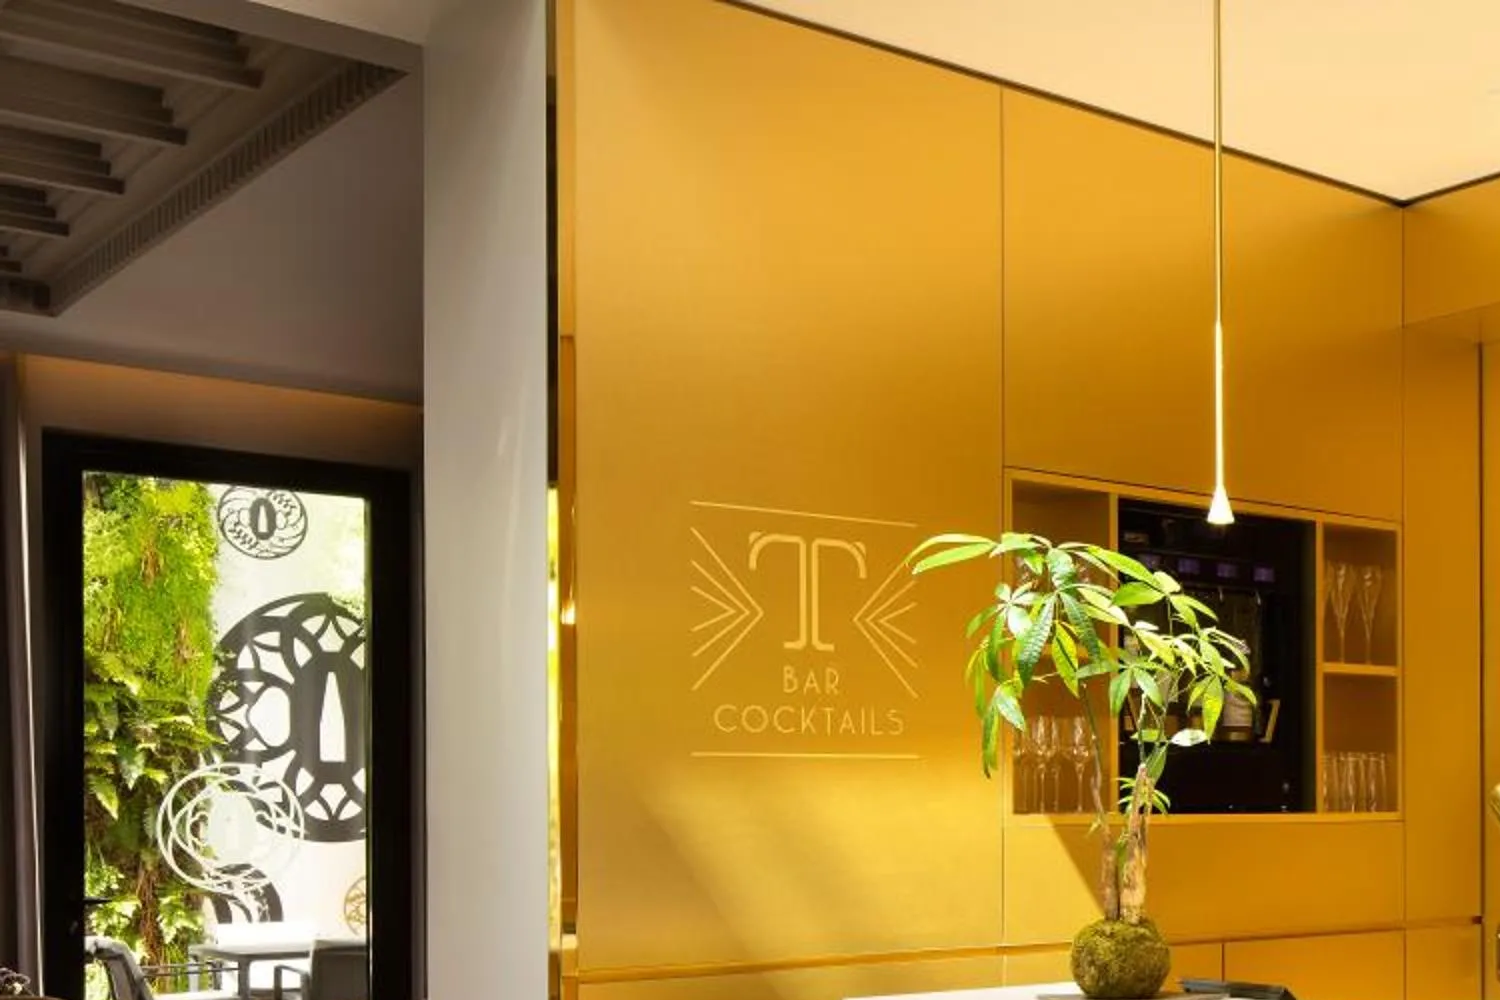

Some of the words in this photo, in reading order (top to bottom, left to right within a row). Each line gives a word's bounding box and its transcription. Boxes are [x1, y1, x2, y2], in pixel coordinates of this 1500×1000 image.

[749, 532, 867, 651] T
[783, 665, 840, 694] BAR
[713, 705, 904, 735] COCKTAILS
